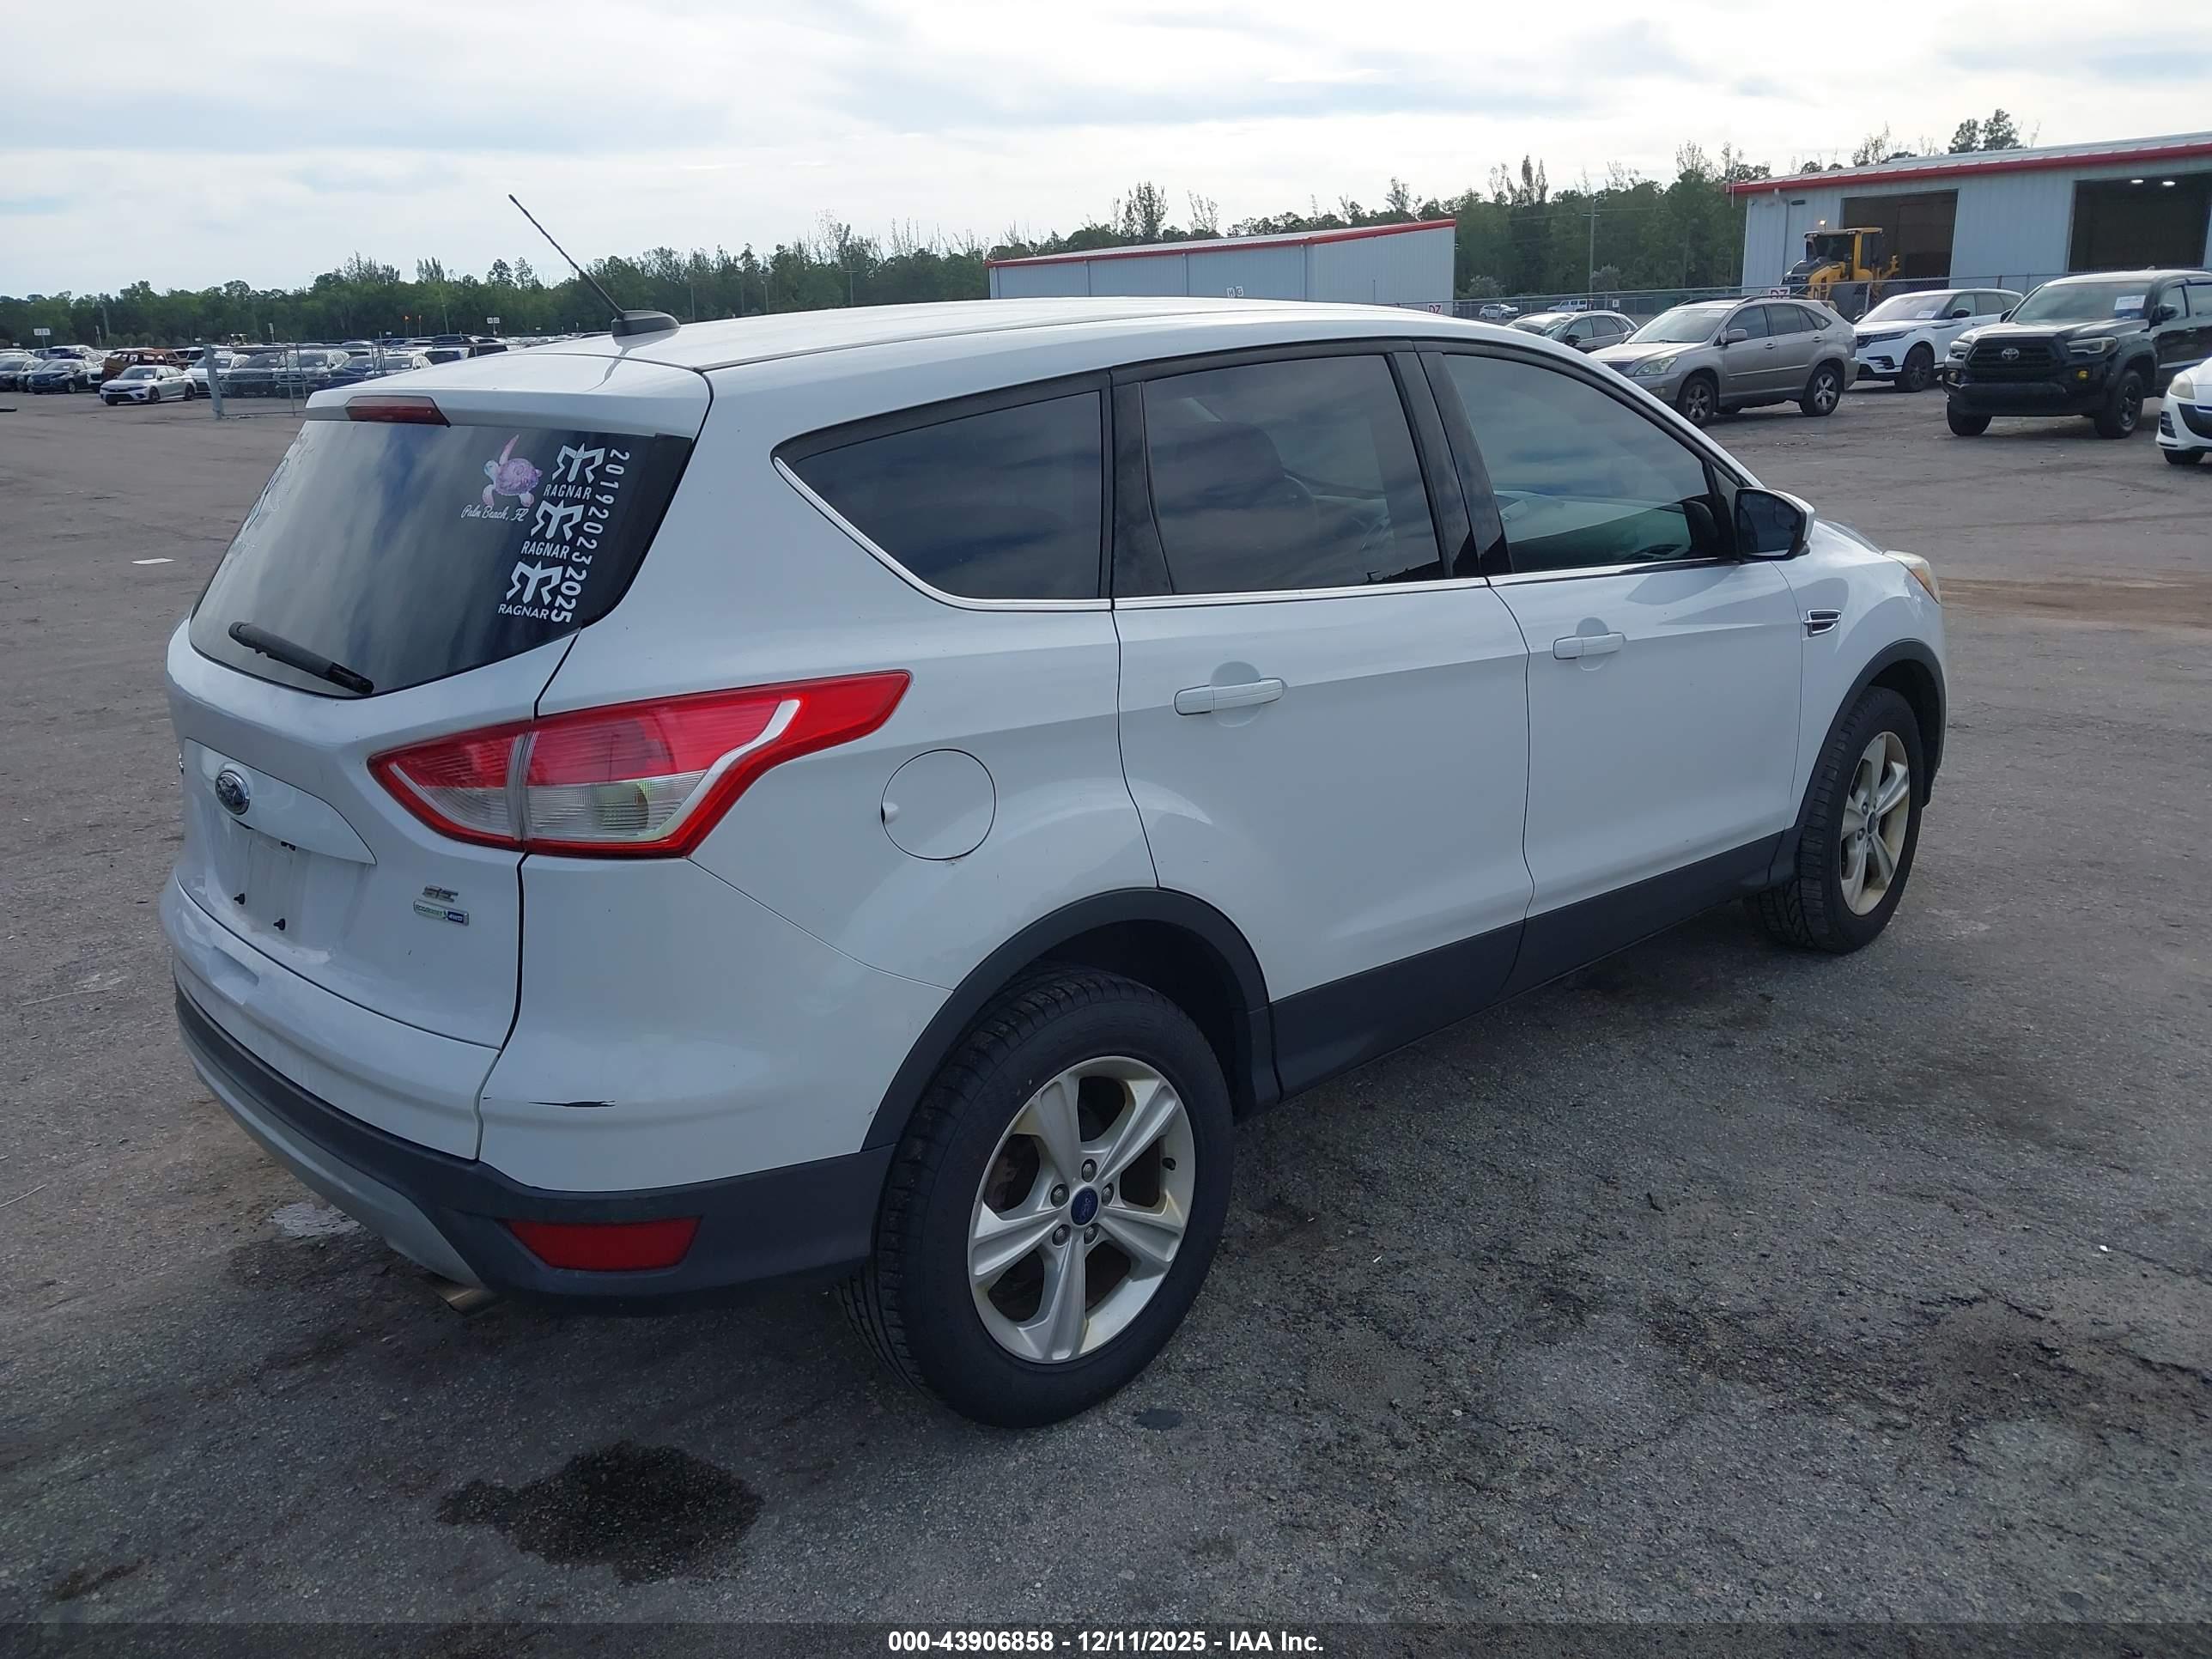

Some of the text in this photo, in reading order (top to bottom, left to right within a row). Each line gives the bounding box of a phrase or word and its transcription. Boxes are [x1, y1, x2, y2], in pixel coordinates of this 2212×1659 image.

[543, 483, 592, 501] RAGNAR
[460, 504, 481, 519] Palm
[520, 540, 570, 560] RAGNAR
[498, 604, 550, 620] RAGNAR
